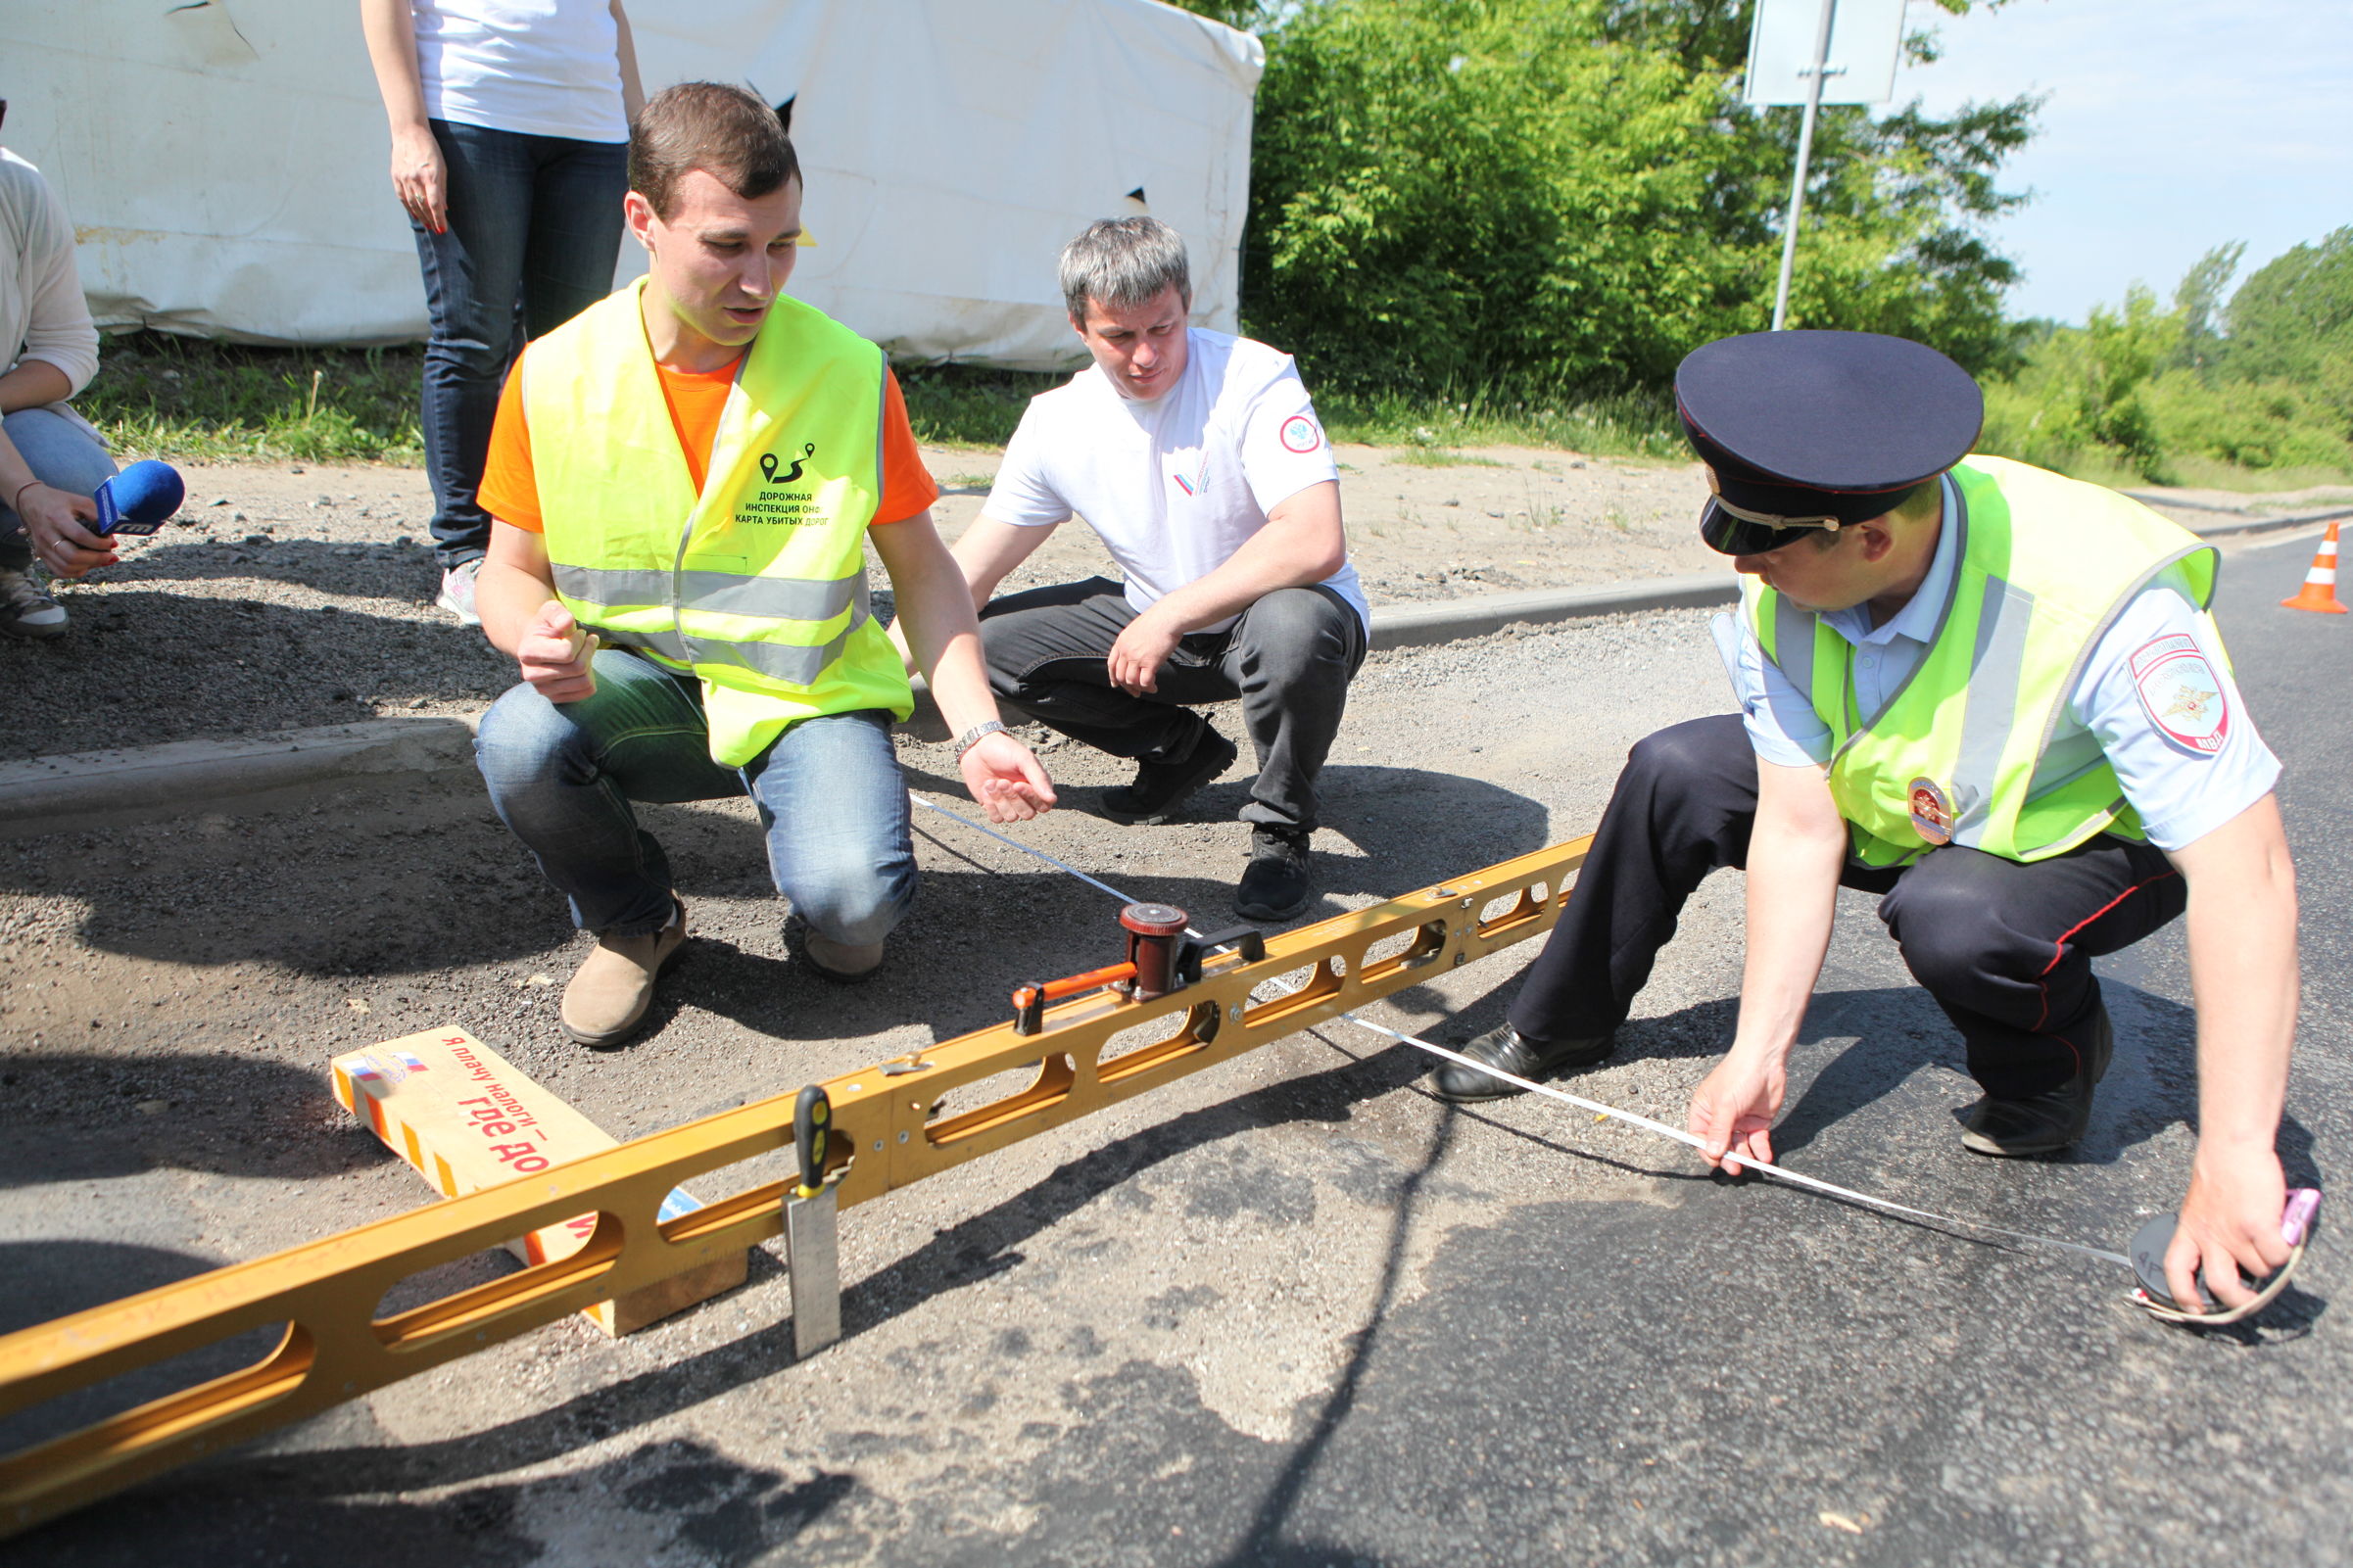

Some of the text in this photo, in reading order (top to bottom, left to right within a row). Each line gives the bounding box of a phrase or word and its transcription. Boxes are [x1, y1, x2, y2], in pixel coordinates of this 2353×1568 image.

[759, 492, 812, 501] ДОРОЖНАЯ
[745, 503, 800, 514] ИНСПЕКЦИЯ
[735, 514, 829, 526] КАРТА УБИТЫХ ДОРОГ
[441, 1036, 466, 1046] Я
[451, 1047, 496, 1081] плачу
[484, 1083, 538, 1127] налоги
